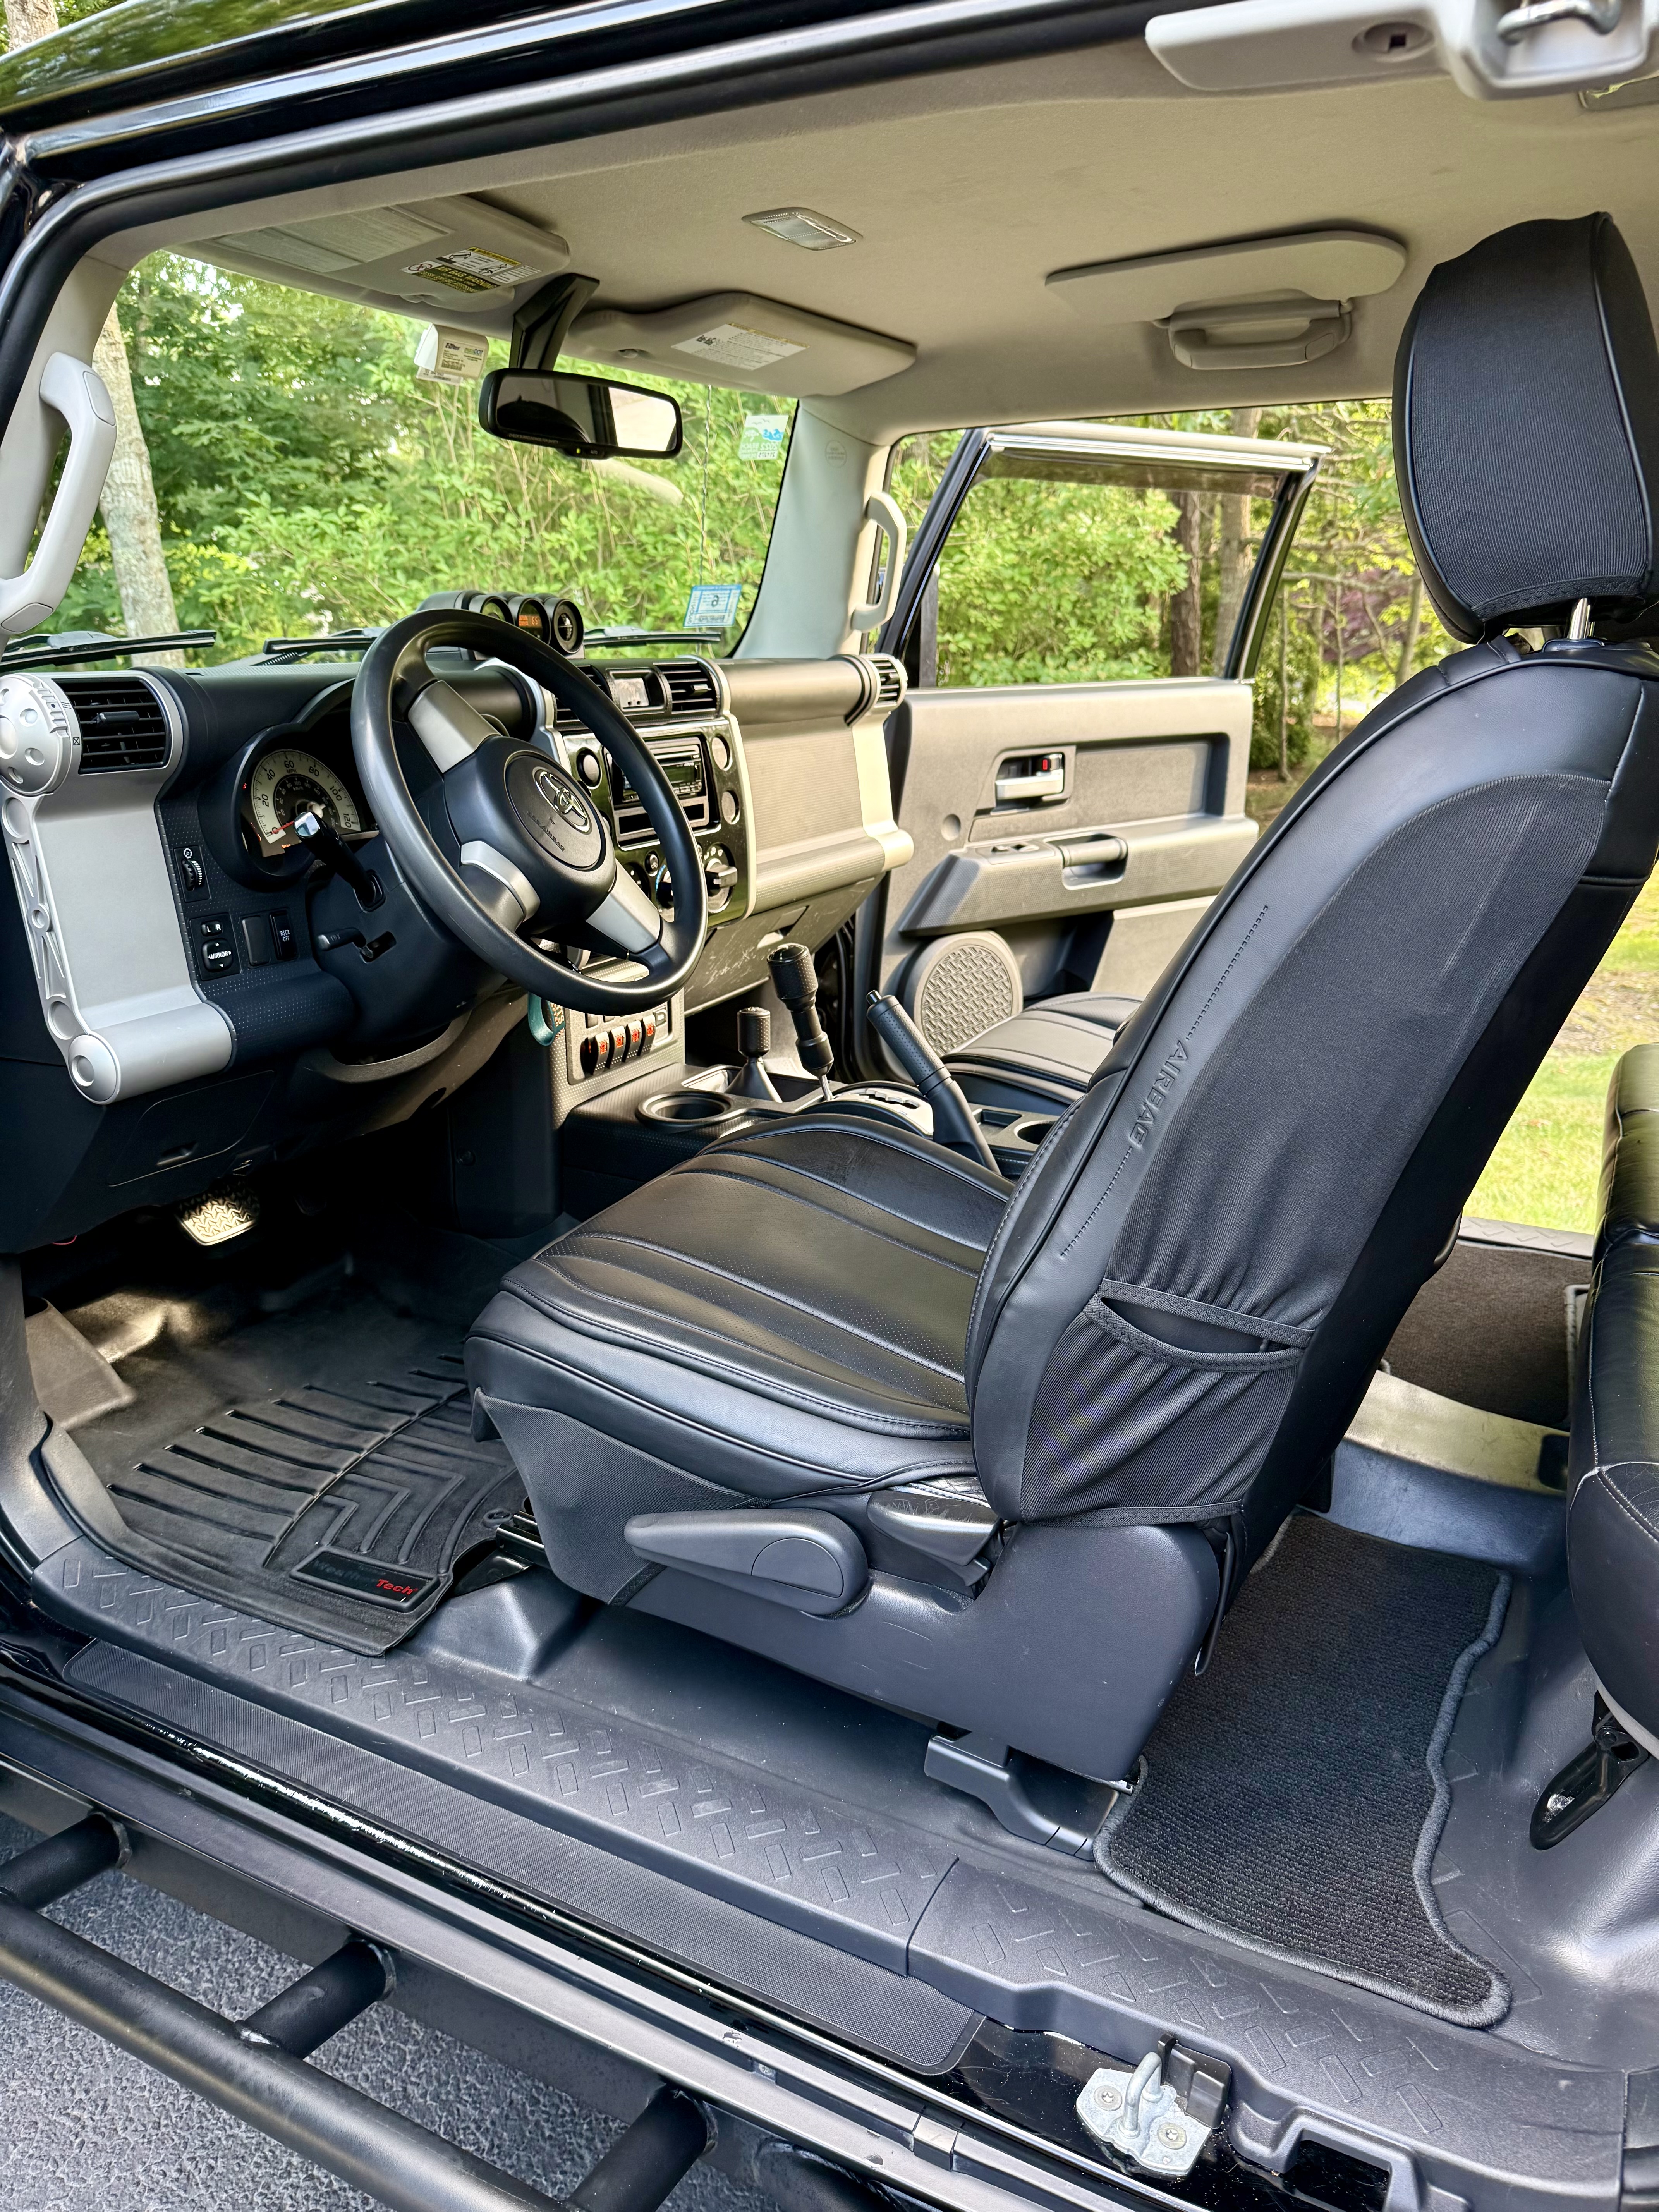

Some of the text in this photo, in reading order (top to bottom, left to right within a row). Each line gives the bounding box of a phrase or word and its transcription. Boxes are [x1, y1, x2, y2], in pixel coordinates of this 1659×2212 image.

[284, 760, 294, 769] 60
[267, 769, 275, 781] 40
[309, 766, 319, 777] 80
[330, 786, 342, 801] 100
[262, 794, 269, 807] 20
[343, 813, 352, 828] 120
[211, 951, 229, 960] MIRROR
[1128, 1040, 1188, 1149] AIRBAG
[376, 1579, 414, 1595] Tech
